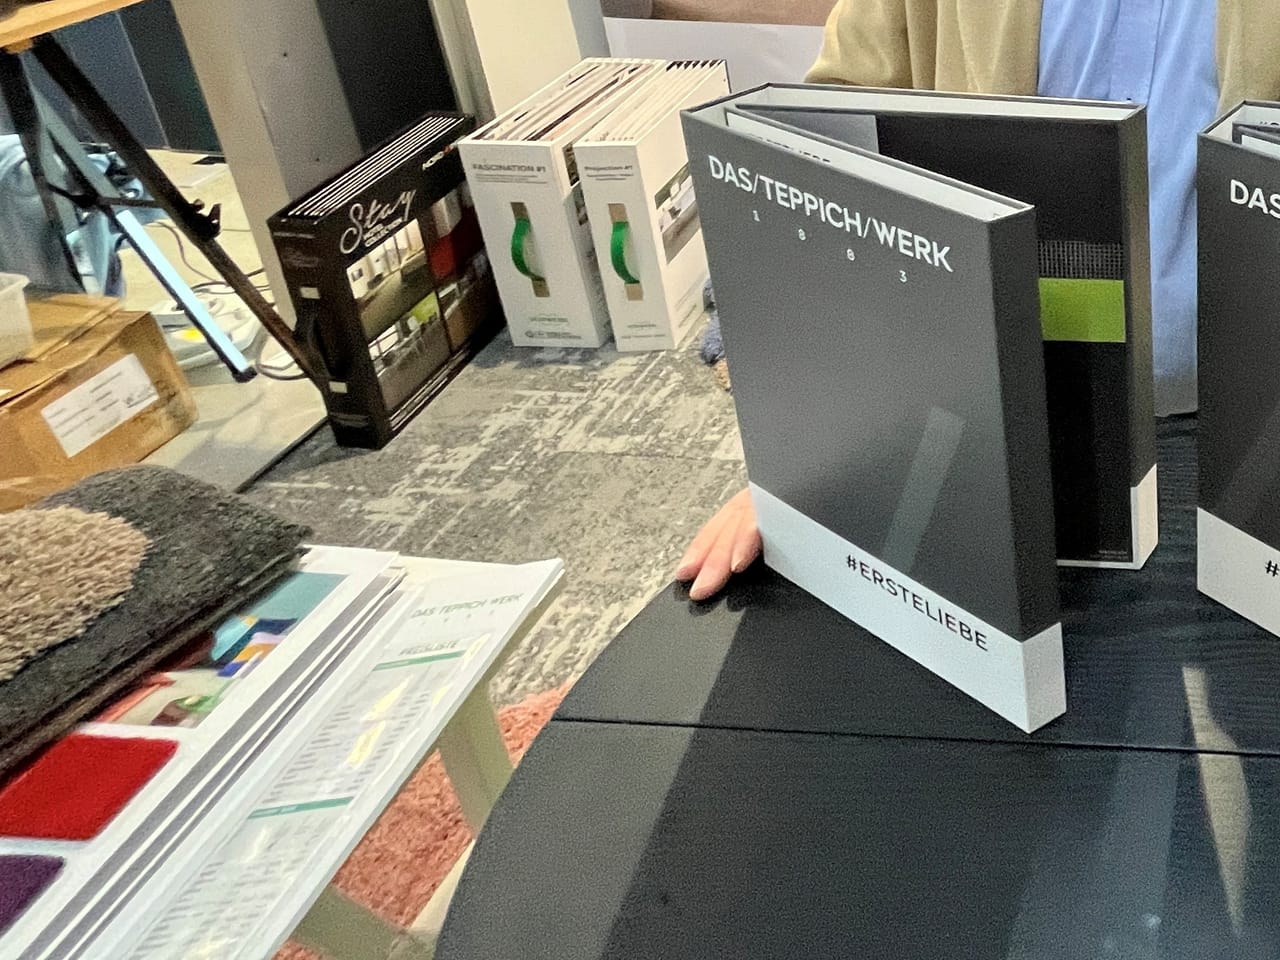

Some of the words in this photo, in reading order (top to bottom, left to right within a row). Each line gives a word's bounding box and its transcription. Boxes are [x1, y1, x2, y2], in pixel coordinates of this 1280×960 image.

[472, 163, 534, 173] FASCINATION
[340, 189, 417, 254] Stay
[707, 154, 954, 273] DAS/TEPPICH/WERK
[752, 209, 761, 222] 1
[797, 228, 807, 242] 8
[846, 248, 856, 262] 8
[899, 269, 908, 284] 3
[846, 553, 989, 652] #ERSTELIEBE
